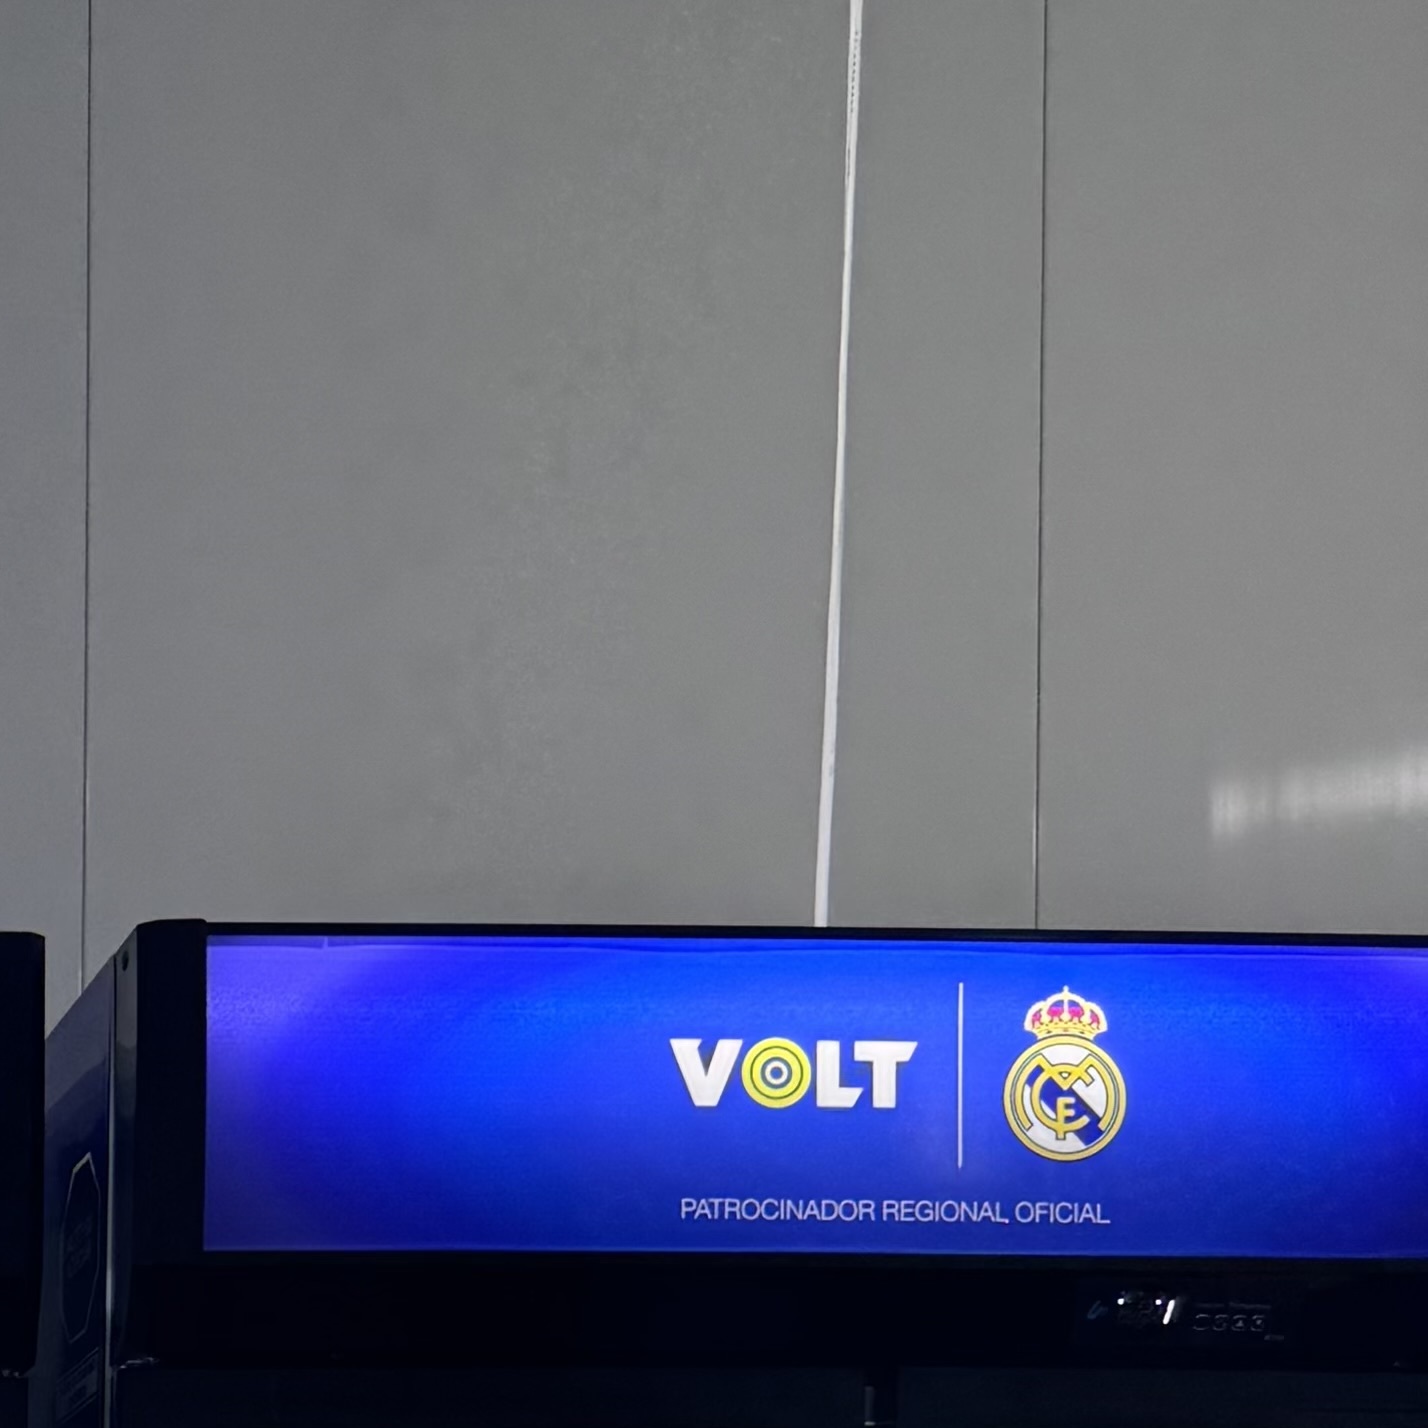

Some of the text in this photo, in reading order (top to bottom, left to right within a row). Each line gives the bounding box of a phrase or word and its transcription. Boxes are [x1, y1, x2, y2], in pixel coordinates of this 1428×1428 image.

[669, 1036, 918, 1109] VOLT
[681, 1198, 1111, 1225] PATROCINADOR REGIONAL OFICIAL
